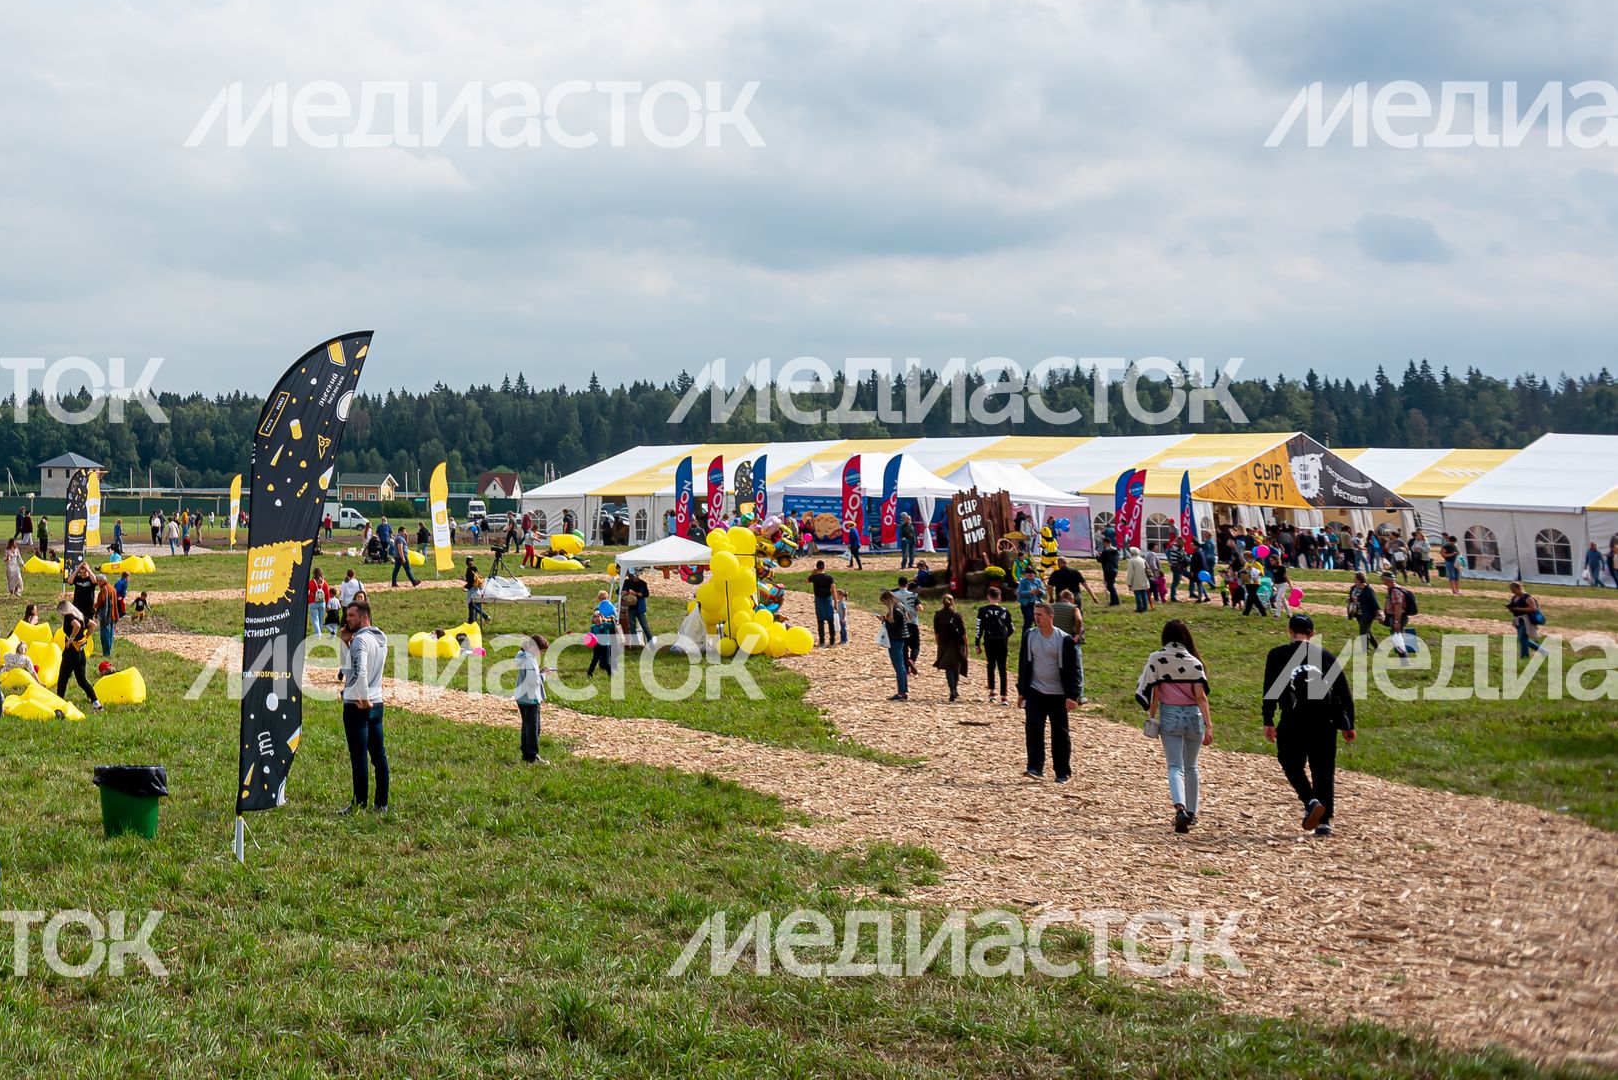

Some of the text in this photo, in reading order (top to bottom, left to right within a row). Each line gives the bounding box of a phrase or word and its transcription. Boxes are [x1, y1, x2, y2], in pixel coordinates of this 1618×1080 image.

[1253, 461, 1283, 481] СЫР
[1254, 482, 1284, 501] ТУТ!
[677, 479, 692, 523] OZON
[707, 481, 724, 530] OZON
[842, 481, 863, 533] OZON
[957, 499, 978, 516] СЫР
[962, 514, 982, 532] ПИР
[254, 556, 277, 568] СЫР
[251, 569, 275, 581] ПИР
[249, 582, 272, 595] МИР
